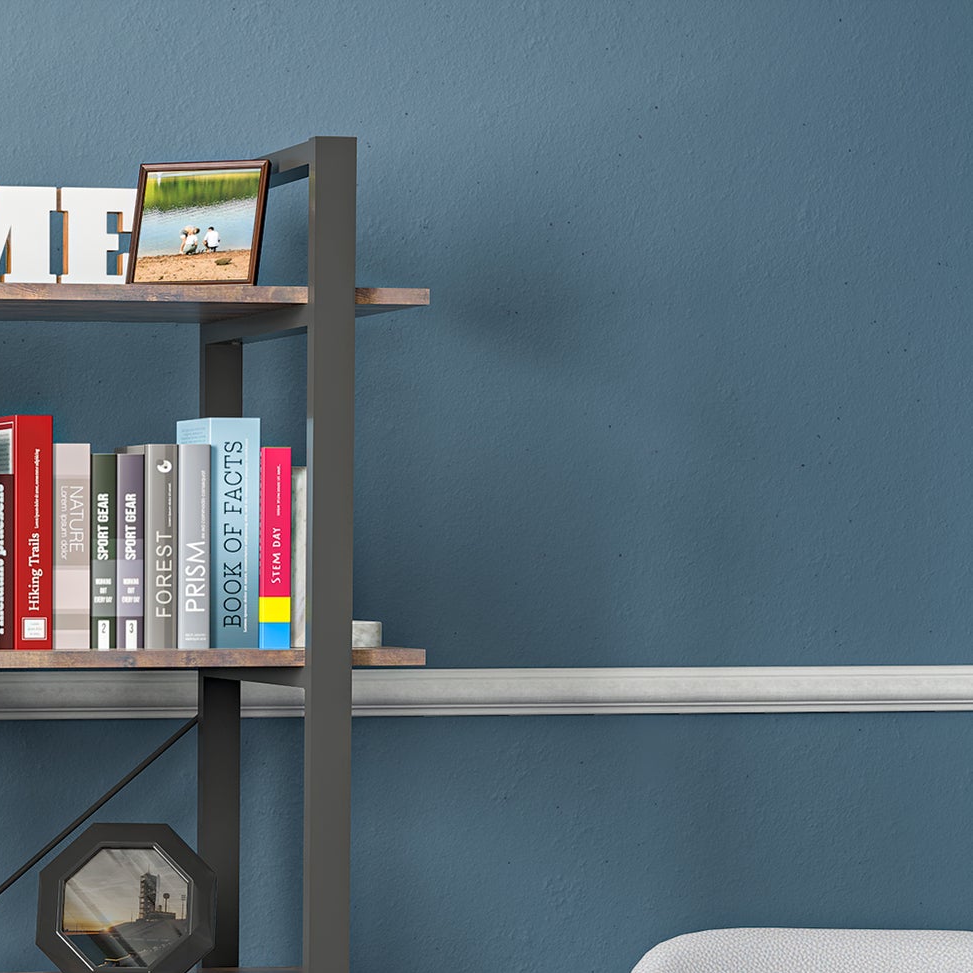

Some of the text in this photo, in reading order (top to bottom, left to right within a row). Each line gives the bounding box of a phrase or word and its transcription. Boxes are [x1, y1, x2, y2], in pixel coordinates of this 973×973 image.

[28, 533, 40, 566] Trails
[69, 486, 84, 553] NATURE
[97, 493, 109, 560] SPORT GEAR
[125, 493, 136, 560] SPORT GEAR
[223, 441, 242, 628] BOOK OF FACTS
[28, 568, 43, 611] Hiking
[156, 531, 172, 618] FOREST
[185, 541, 206, 612] PRISM
[271, 528, 281, 584] STEM DAY
[102, 622, 106, 634] 2
[129, 622, 134, 634] 3
